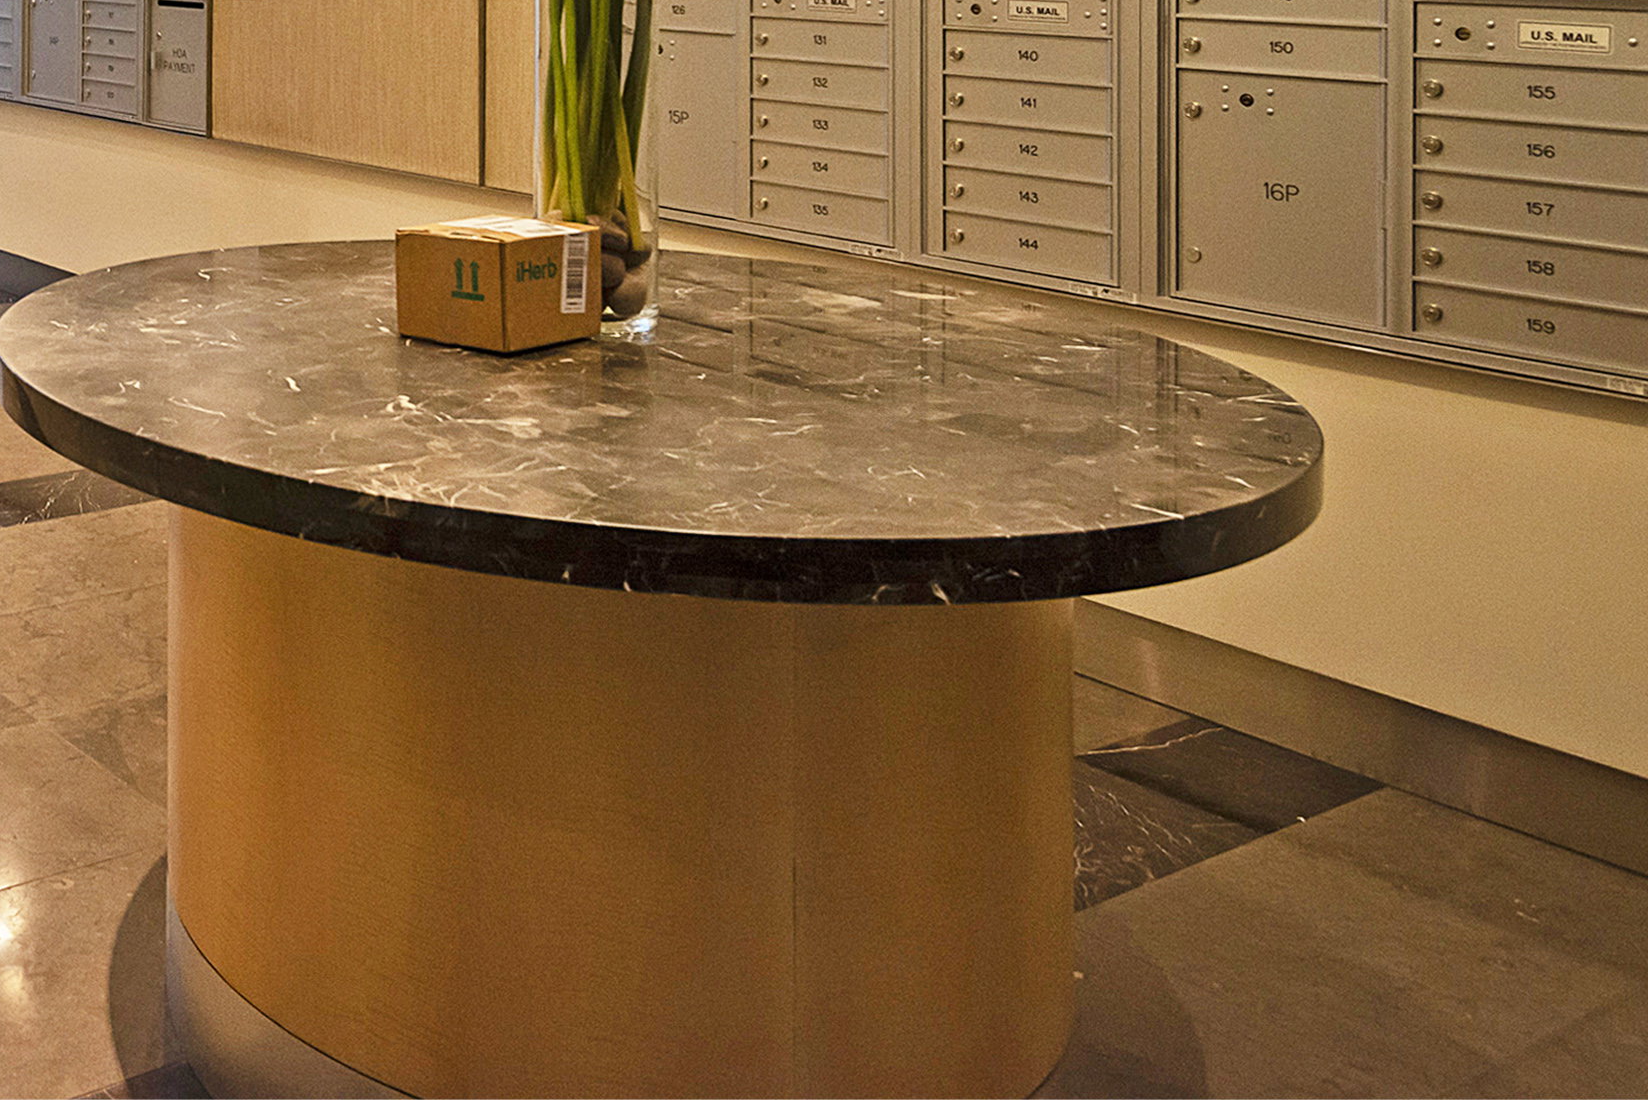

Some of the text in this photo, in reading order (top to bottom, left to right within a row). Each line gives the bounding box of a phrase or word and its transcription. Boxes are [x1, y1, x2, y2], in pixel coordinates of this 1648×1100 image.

[672, 5, 685, 14] 126
[1015, 6, 1060, 16] U.S. MAIL
[814, 35, 826, 45] 131
[1530, 30, 1598, 44] U.S. MAIL
[1270, 42, 1293, 54] 150
[1018, 50, 1038, 61] 140
[163, 60, 195, 74] PAYMENT
[813, 77, 827, 88] 132
[1527, 85, 1555, 99] 155
[1021, 98, 1036, 108] 141
[669, 110, 689, 124] 15P
[813, 120, 828, 130] 133
[1019, 144, 1038, 156] 142
[1527, 144, 1555, 158] 156
[813, 162, 828, 172] 134
[1019, 191, 1038, 203] 143
[1264, 182, 1299, 202] 16P
[813, 205, 828, 215] 135
[1526, 202, 1554, 216] 157
[1019, 238, 1038, 249] 144
[516, 256, 558, 283] iHerb
[1527, 260, 1554, 276] 158
[1527, 319, 1555, 334] 159
